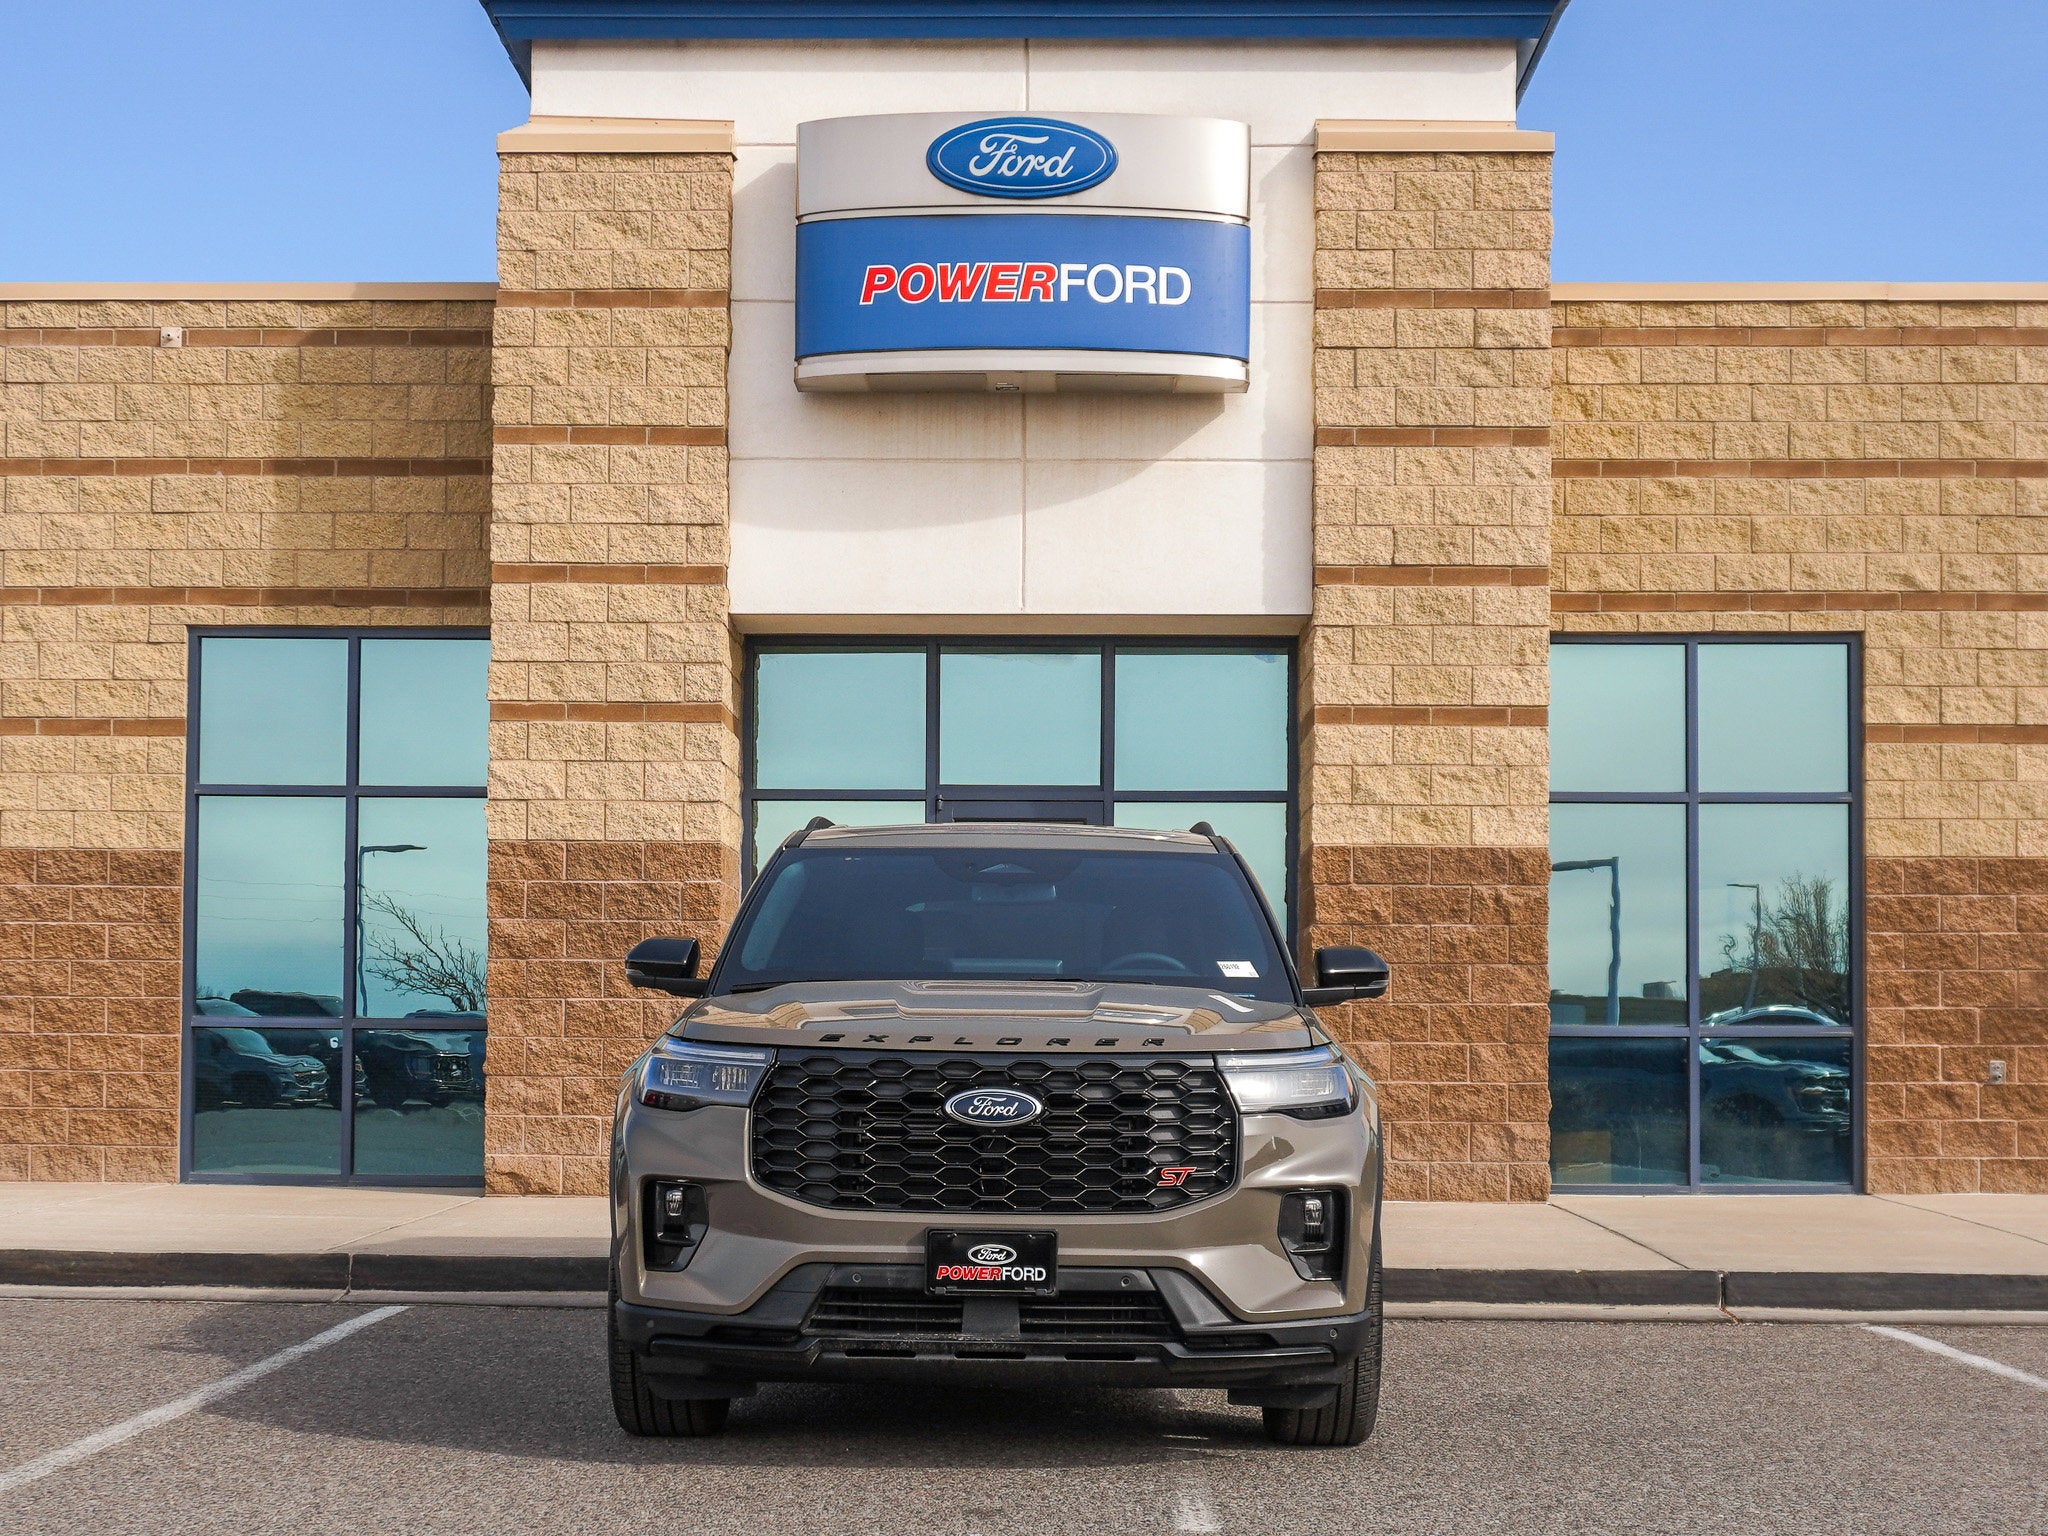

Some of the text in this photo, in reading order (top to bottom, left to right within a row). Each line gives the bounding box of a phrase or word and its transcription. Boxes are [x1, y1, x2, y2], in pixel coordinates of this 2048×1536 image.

[969, 133, 1075, 178] Ford
[859, 262, 1192, 305] POWERFORD
[818, 1033, 1166, 1047] EXPLORER
[968, 1096, 1019, 1118] Ford
[1157, 1166, 1197, 1187] ST
[977, 1246, 1008, 1262] Ford
[935, 1264, 1047, 1283] POWERFORD
